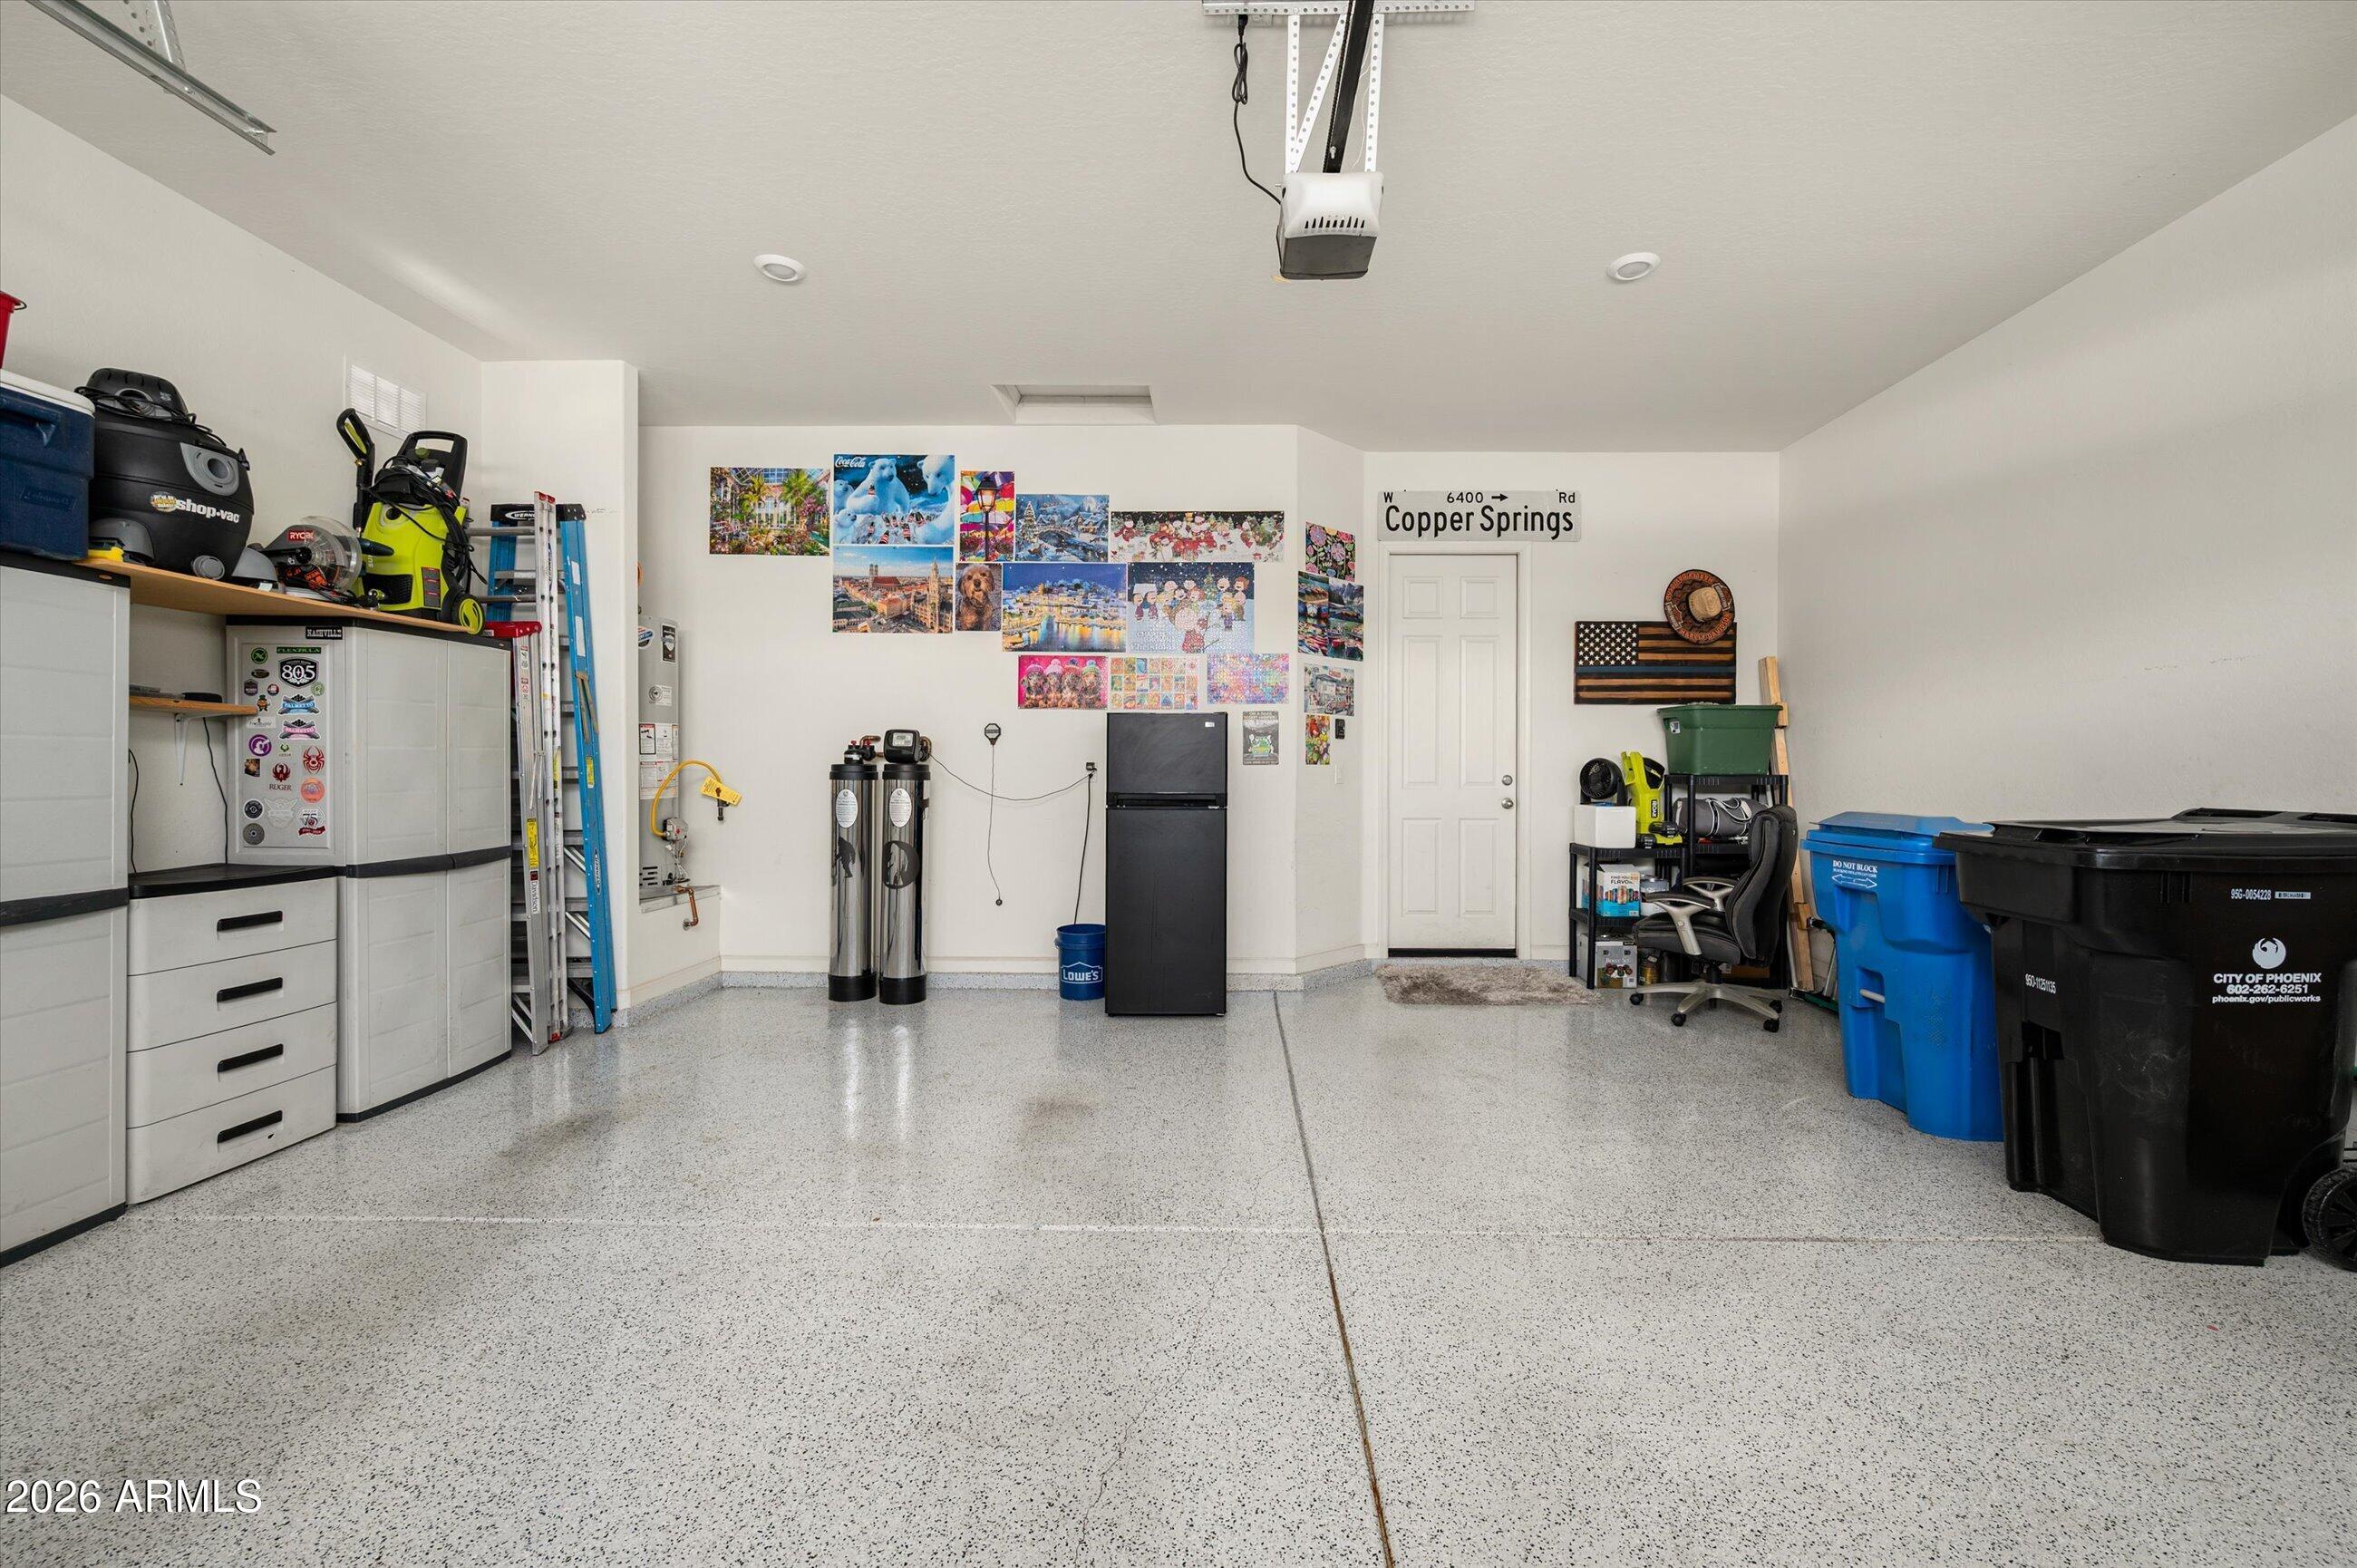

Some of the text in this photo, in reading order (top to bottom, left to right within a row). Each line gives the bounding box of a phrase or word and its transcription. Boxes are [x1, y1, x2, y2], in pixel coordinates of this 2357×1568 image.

[1383, 491, 1576, 504] W 6400 Rd
[1385, 505, 1574, 541] Copper Springs
[306, 628, 343, 638] NASHVILLE
[281, 664, 316, 680] 805
[1843, 862, 1856, 870] NOT
[1857, 864, 1877, 873] BLOCK
[1062, 969, 1100, 982] LOWE'S
[2213, 973, 2322, 983] CITY OF PHOENIX
[2226, 984, 2309, 994] 602-262-6251
[2211, 995, 2322, 1004] phoenix.gov/publicworks
